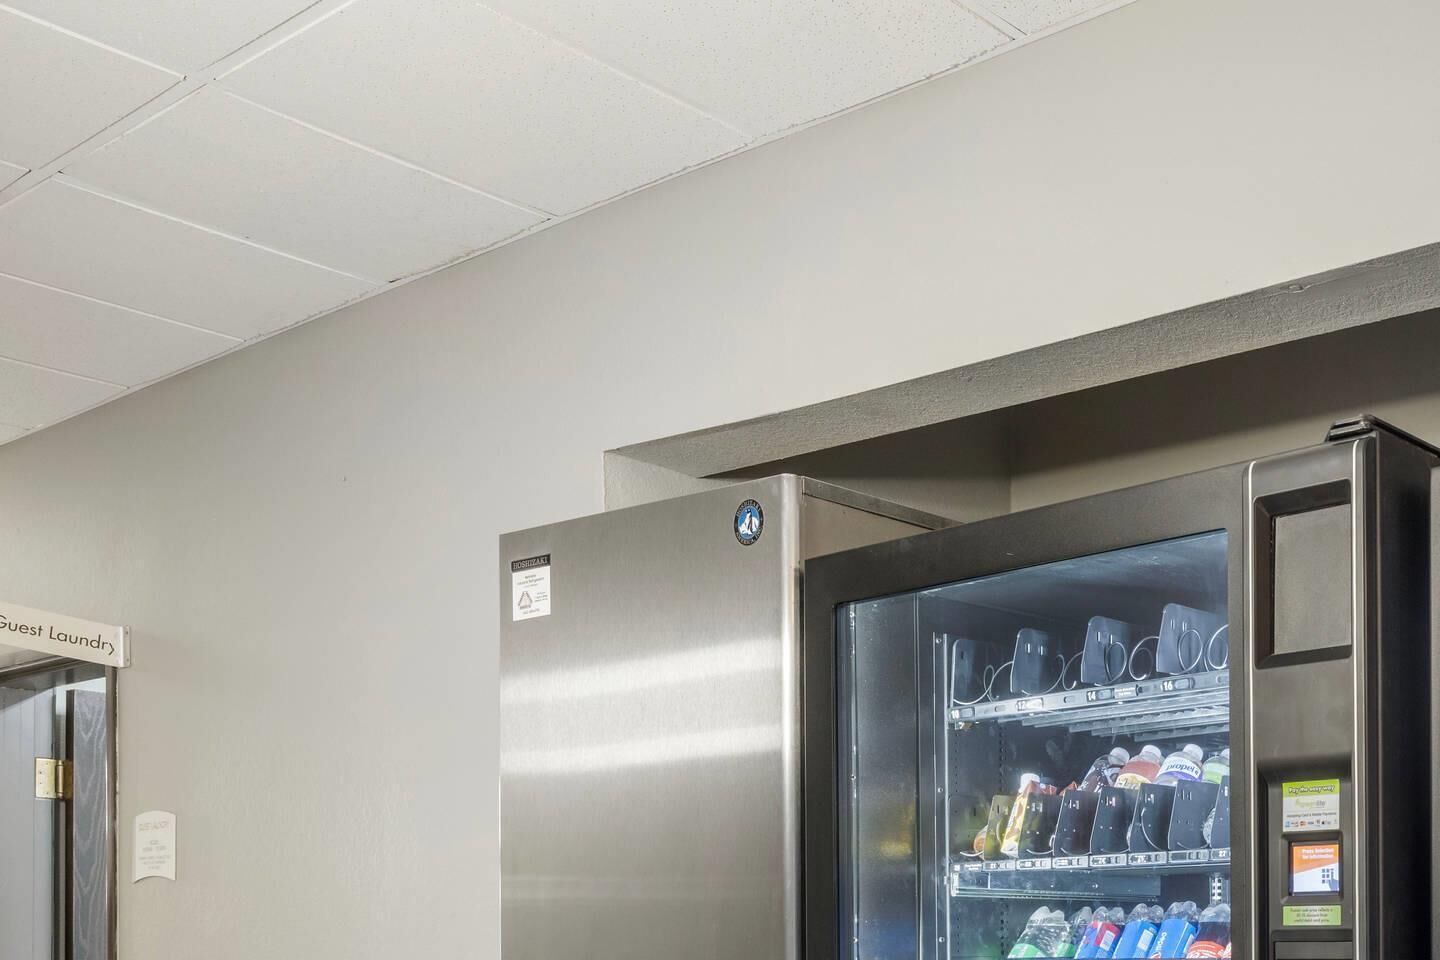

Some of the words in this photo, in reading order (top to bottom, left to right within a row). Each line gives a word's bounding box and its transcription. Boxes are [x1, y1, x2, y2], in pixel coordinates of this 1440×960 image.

[0, 614, 43, 637] Guest
[49, 625, 115, 656] Laundry
[1163, 680, 1173, 690] 16
[1087, 691, 1096, 700] 14
